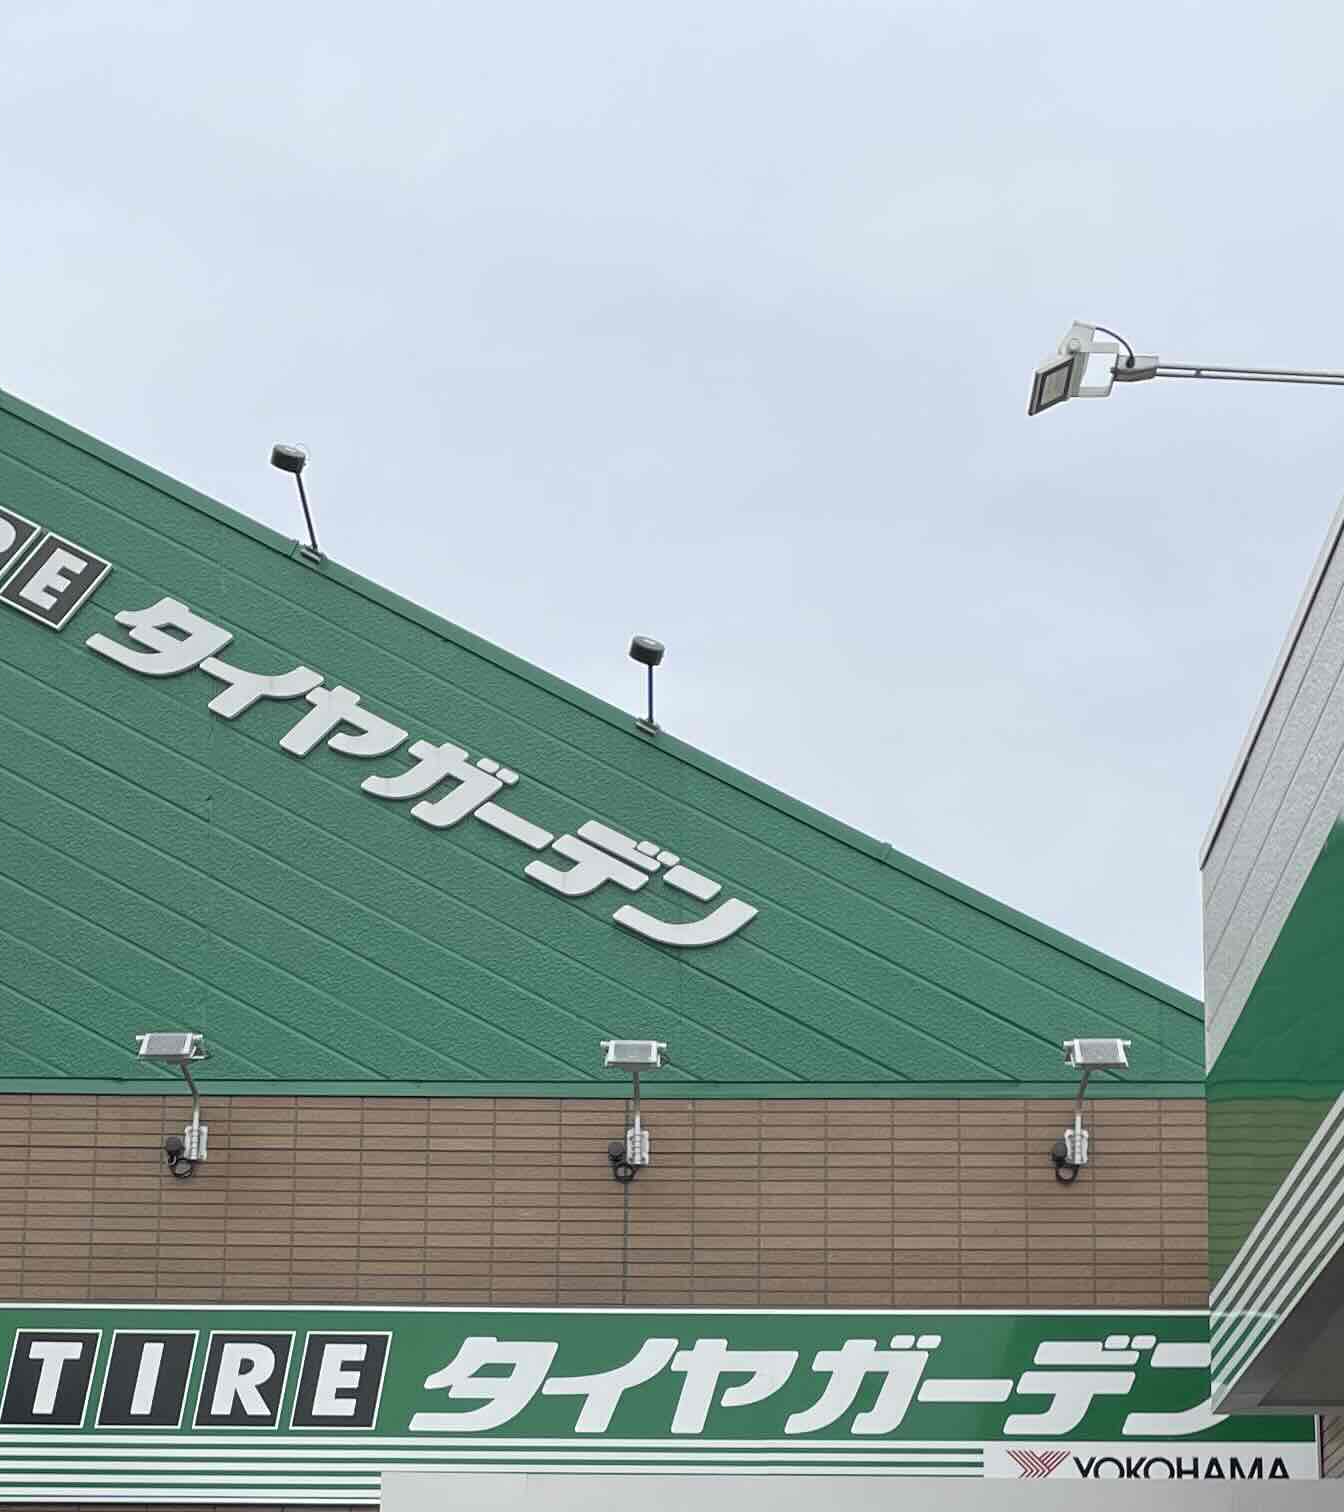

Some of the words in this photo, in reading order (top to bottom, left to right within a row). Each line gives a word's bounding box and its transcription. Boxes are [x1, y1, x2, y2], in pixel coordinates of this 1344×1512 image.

[84, 597, 759, 949] タイヤガーデン
[27, 1341, 369, 1417] TIRE
[407, 1335, 1231, 1436] タイヤガーデン
[1072, 1456, 1290, 1480] YOKOHAMA
